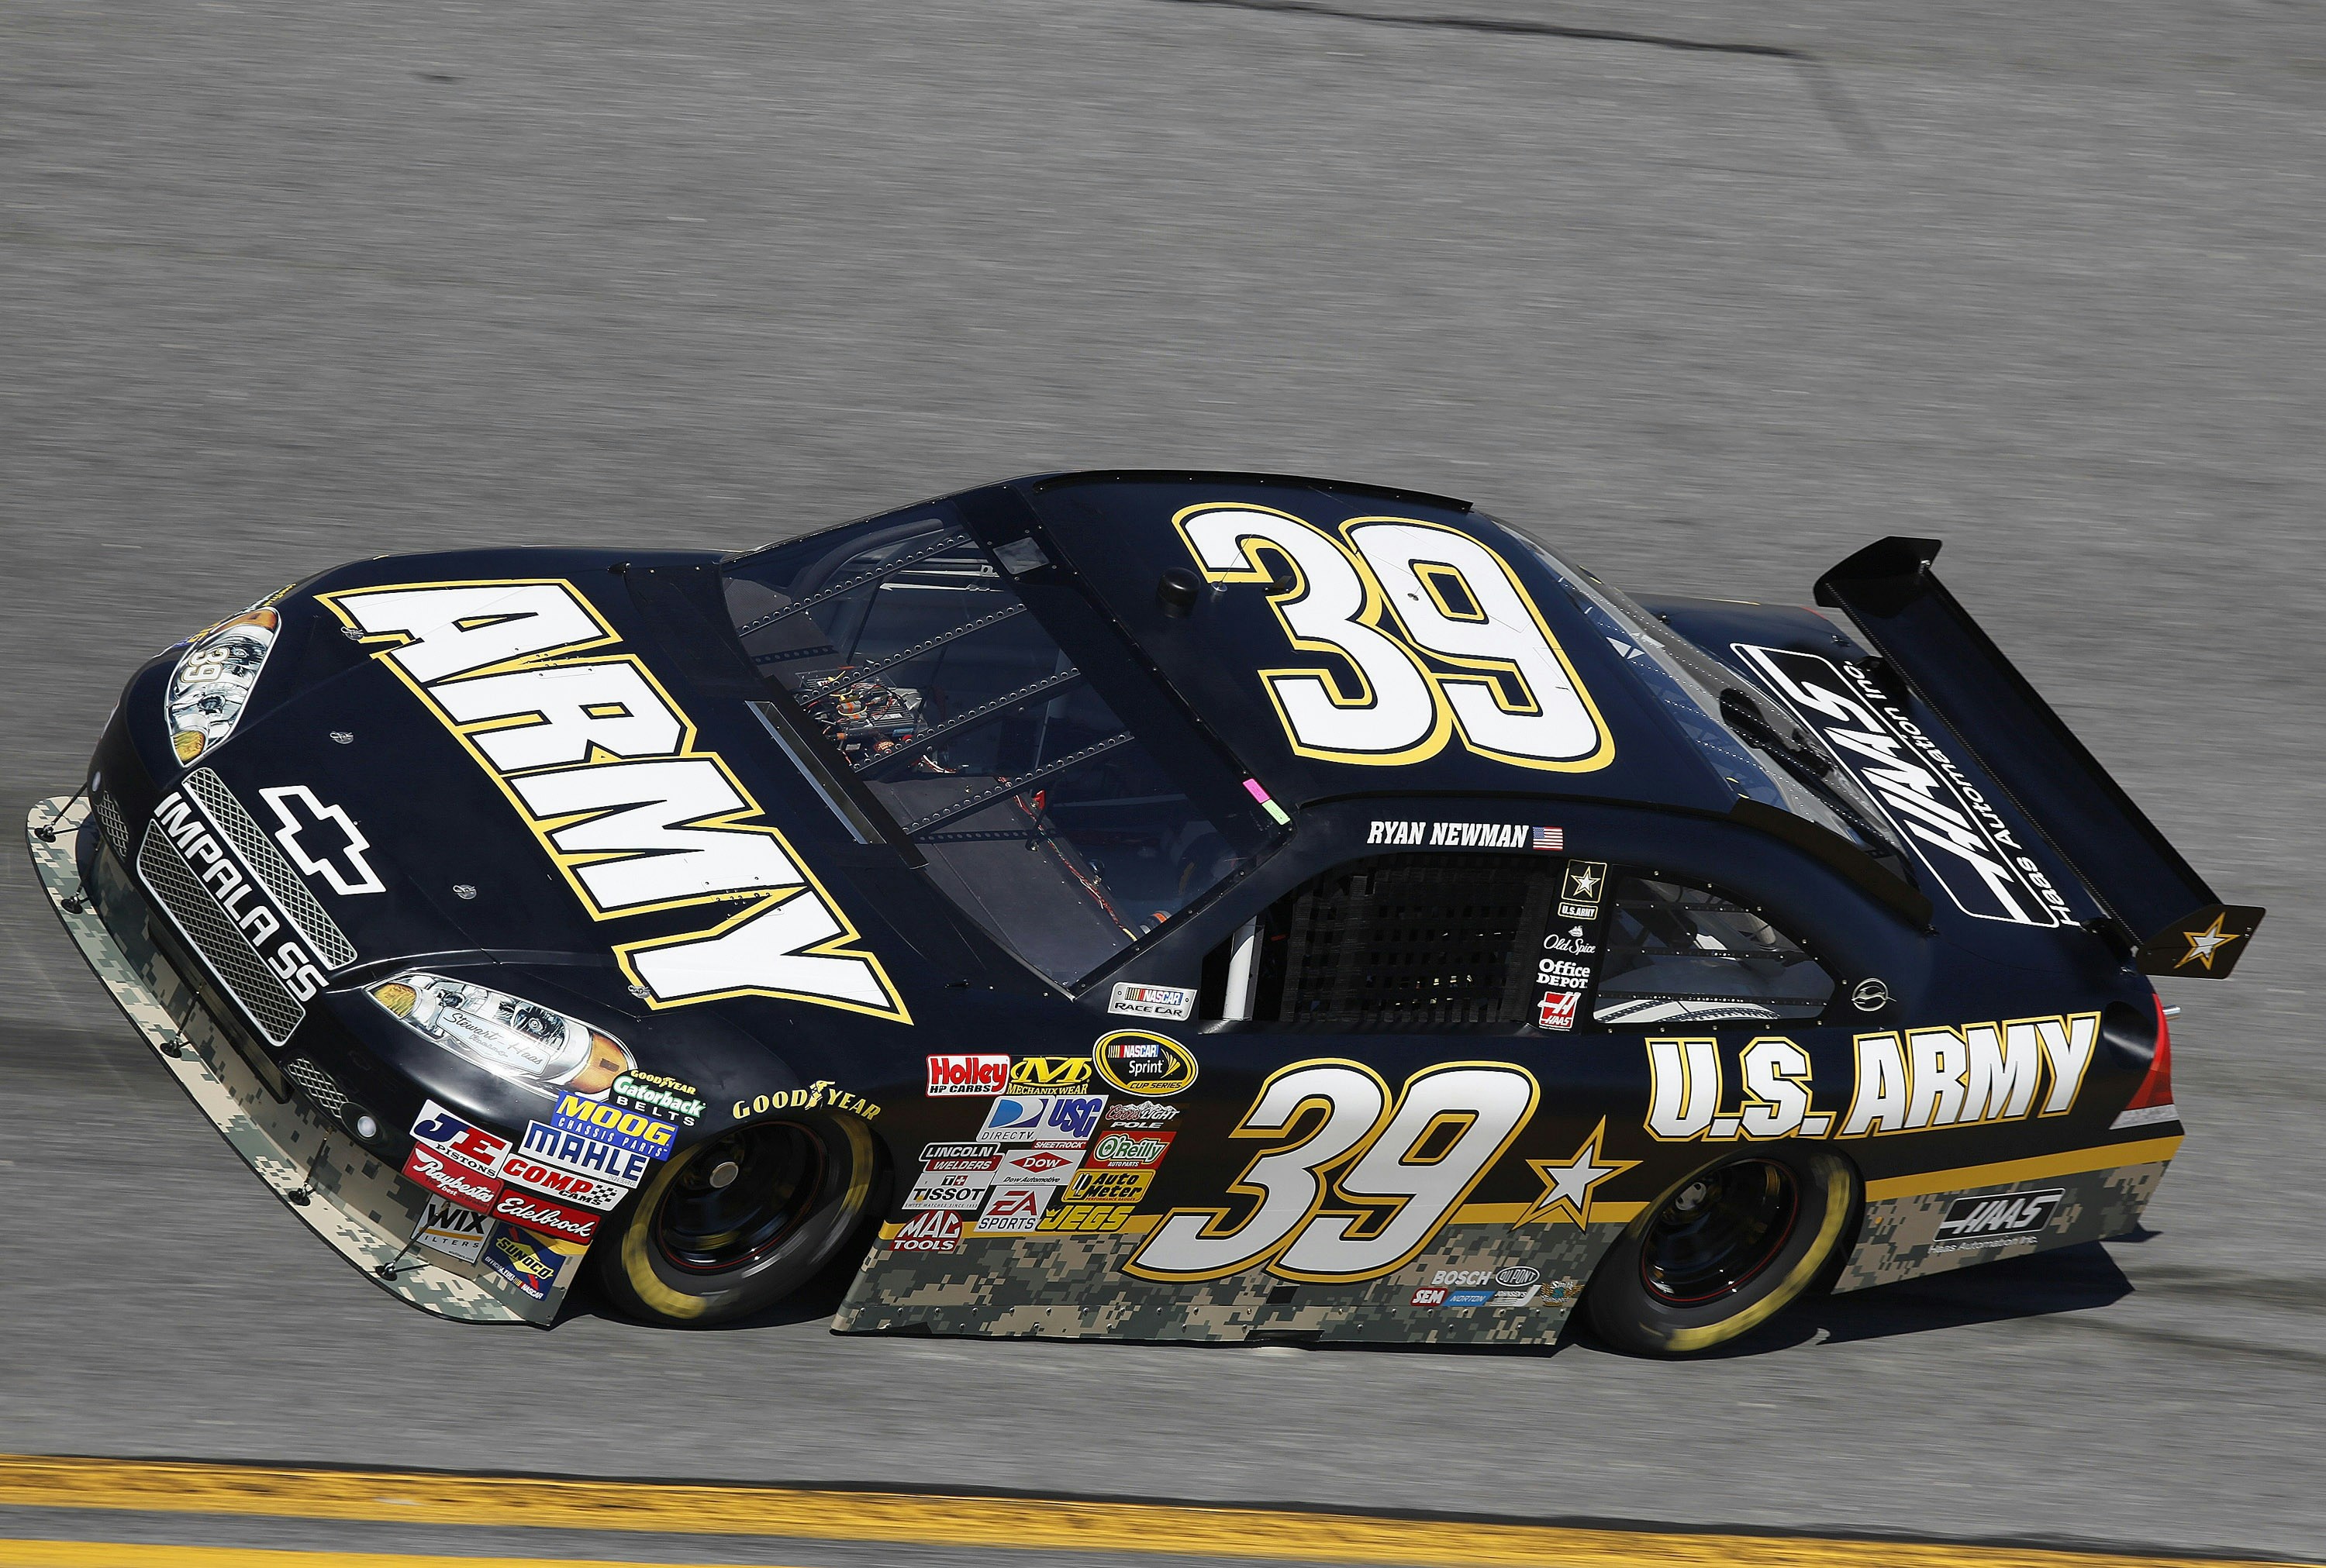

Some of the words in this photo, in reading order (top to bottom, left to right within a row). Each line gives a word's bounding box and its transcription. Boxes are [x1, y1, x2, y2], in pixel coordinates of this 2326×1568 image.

[1172, 501, 1616, 773] 39
[1884, 706, 2022, 849] Automation
[313, 578, 913, 1025] ARMY
[1367, 821, 1426, 845] RYAN
[1429, 822, 1529, 848] NEWMAN
[154, 791, 280, 946] IMPALA
[267, 941, 330, 1002] SS
[2017, 856, 2081, 926] Haas
[1544, 934, 1572, 950] Old
[1568, 938, 1596, 955] Spice
[1536, 973, 1589, 988] DEPOT
[1539, 959, 1590, 977] Office
[1115, 1002, 1151, 1012] RACE
[1155, 1007, 1182, 1016] CAR
[1144, 989, 1180, 1005] NASCAR
[1123, 1045, 1158, 1058] NASCAR
[931, 1057, 1007, 1093] Holley
[1129, 1060, 1163, 1077] Sprint
[1643, 1036, 1836, 1141] U.S.
[1834, 1011, 2101, 1139] ARMY
[613, 1075, 706, 1118] Gatorback
[951, 1085, 990, 1094] CARBS
[1006, 1083, 1058, 1094] MECHANIX
[1059, 1084, 1088, 1094] WEAR
[555, 1095, 673, 1146] MOOG
[616, 1096, 695, 1126] BELTS
[1047, 1098, 1103, 1138] USG
[1106, 1104, 1141, 1120] Coors
[1140, 1108, 1180, 1120] LIGHT
[413, 1113, 507, 1167] JE
[557, 1118, 613, 1142] CHASSIS
[621, 1136, 664, 1157] PARTS
[1095, 1134, 1168, 1163] O'Reilly
[436, 1143, 496, 1177] PISTONS
[523, 1125, 649, 1182] MAHLE
[926, 1147, 993, 1157] LINCOLN
[412, 1148, 495, 1202] Raybestos
[504, 1157, 593, 1196] COMP
[934, 1161, 992, 1170] WELDERS
[1121, 1057, 1541, 1283] 39
[441, 1186, 457, 1197] best
[1086, 1184, 1143, 1198] Meter
[1092, 1173, 1140, 1185] Auto
[558, 1189, 604, 1207] CAMS
[913, 1188, 985, 1201] TISSOT
[988, 1191, 1037, 1216] EA
[427, 1204, 488, 1234] WIX
[497, 1197, 595, 1239] Edelbrock
[897, 1210, 961, 1238] MAC
[978, 1217, 1037, 1230] SPORTS
[1037, 1206, 1135, 1231] JEGS
[1940, 1194, 2062, 1234] HAAS
[425, 1235, 480, 1248] ILTERS
[894, 1240, 954, 1249] TOOLS
[1958, 1236, 2021, 1251] Automation
[497, 1238, 552, 1278] SUNOCO
[1431, 1270, 1493, 1285] BOSCH
[521, 1283, 544, 1299] NASCAR
[1412, 1290, 1445, 1304] SEM
